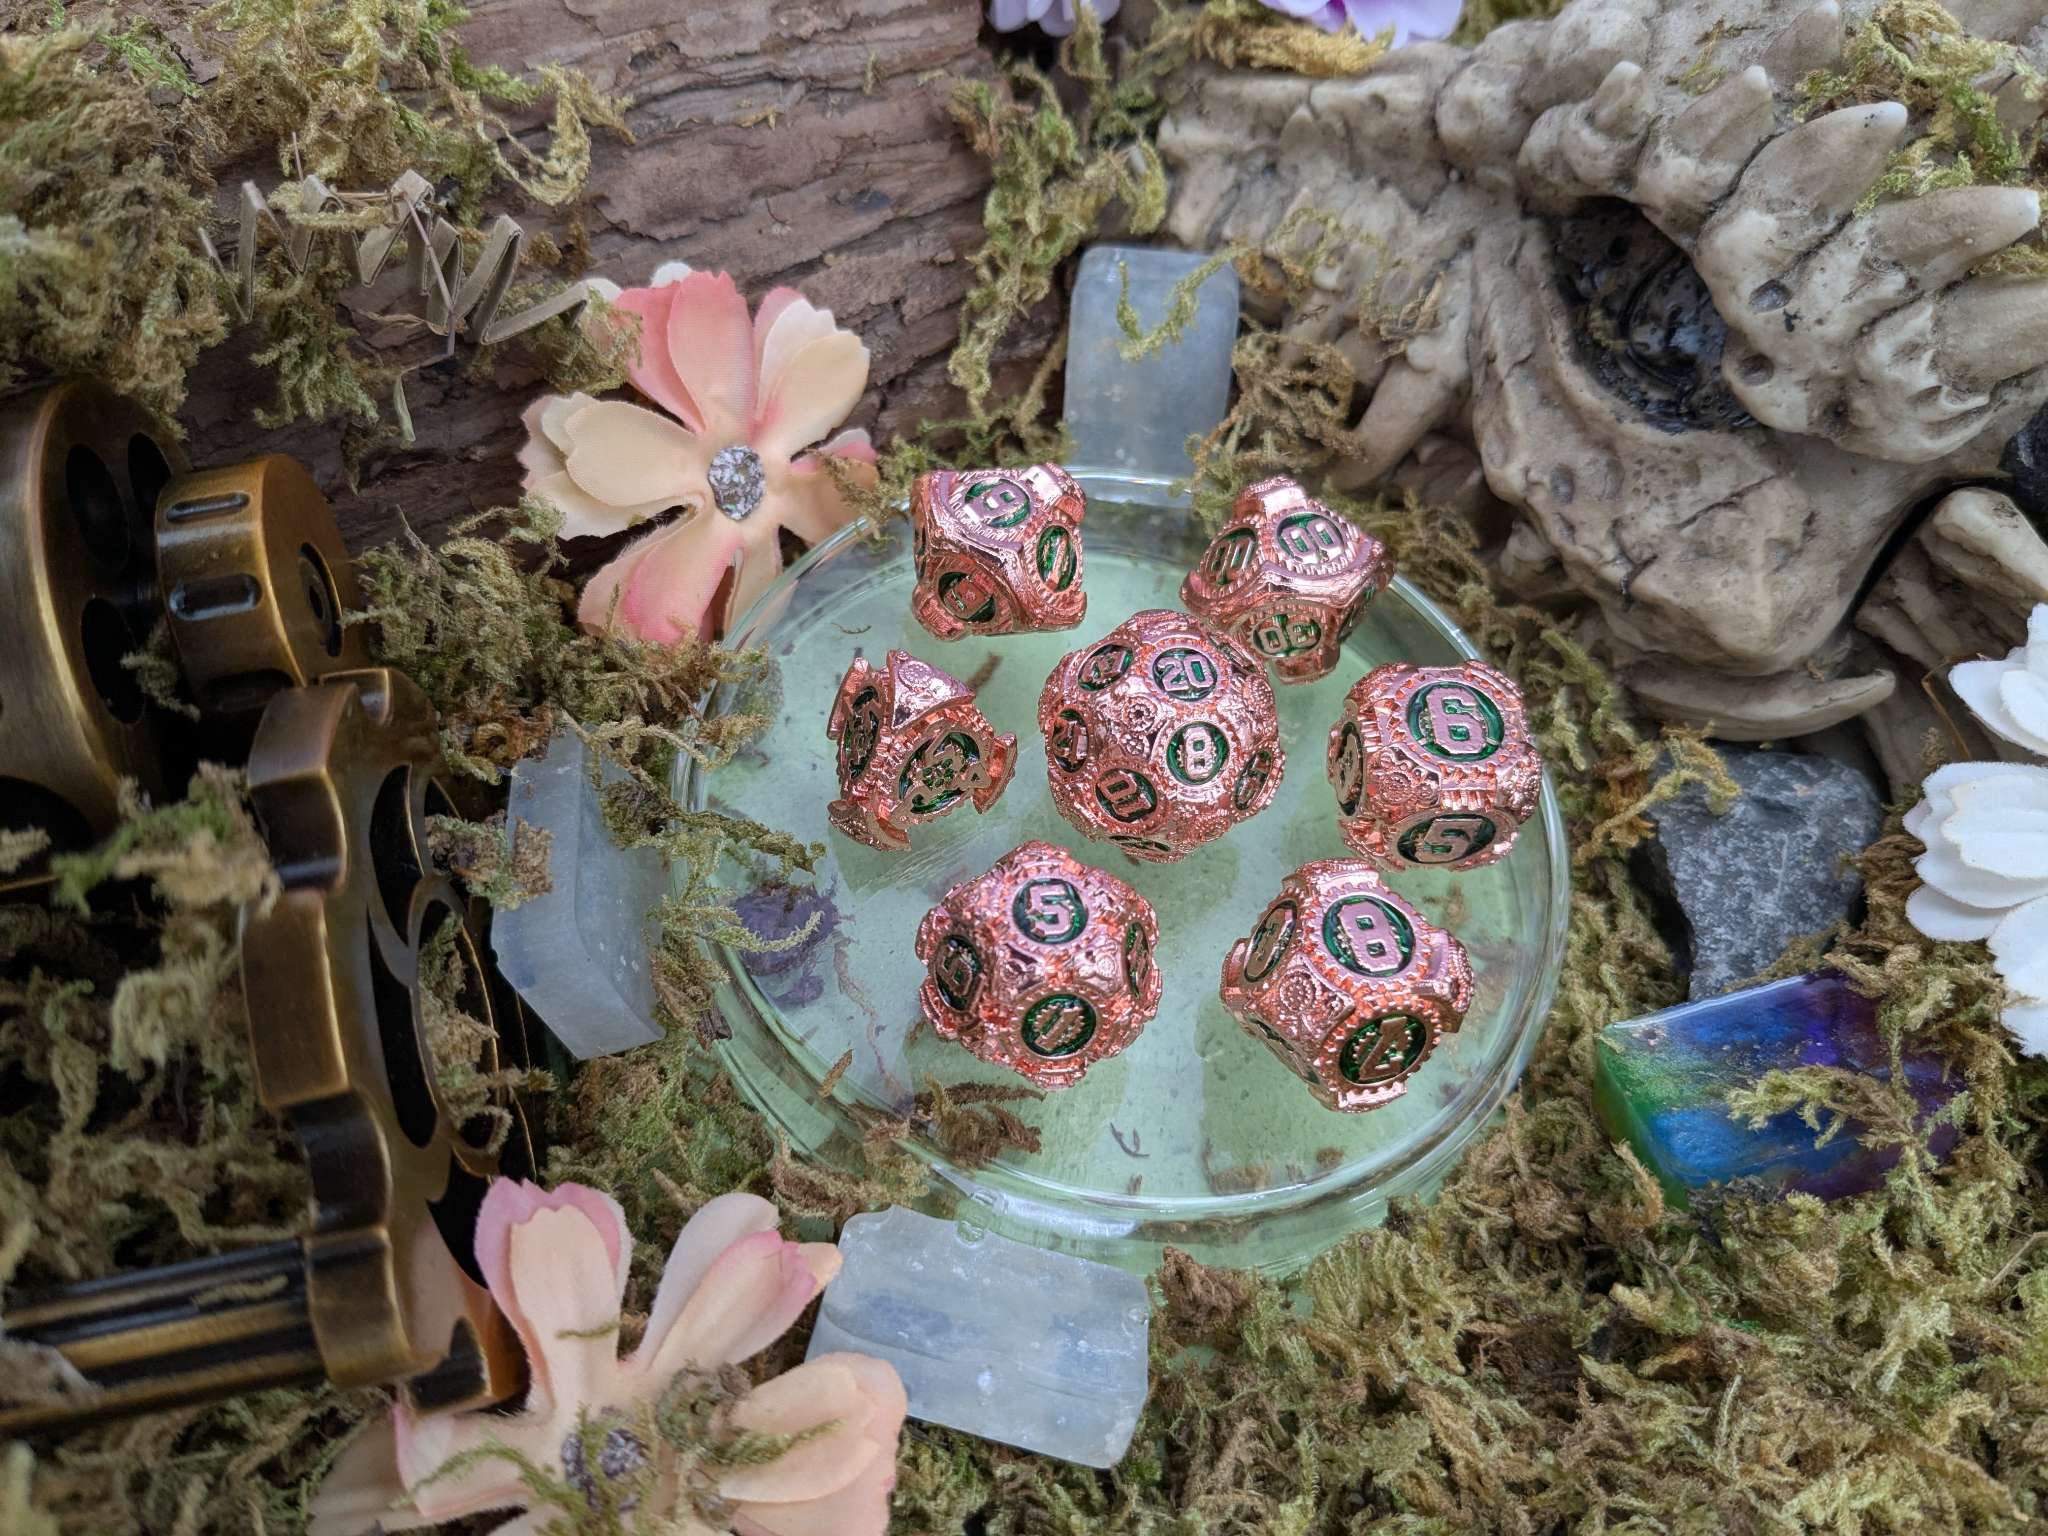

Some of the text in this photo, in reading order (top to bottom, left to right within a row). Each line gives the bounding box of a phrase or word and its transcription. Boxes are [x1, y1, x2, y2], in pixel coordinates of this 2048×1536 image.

[1281, 518, 1343, 563] 00
[1157, 654, 1211, 691] 20
[1426, 687, 1487, 753] 6
[1182, 726, 1216, 778] 8
[1415, 818, 1483, 863] 5
[1028, 884, 1074, 936] 5
[1337, 901, 1403, 971] 8
